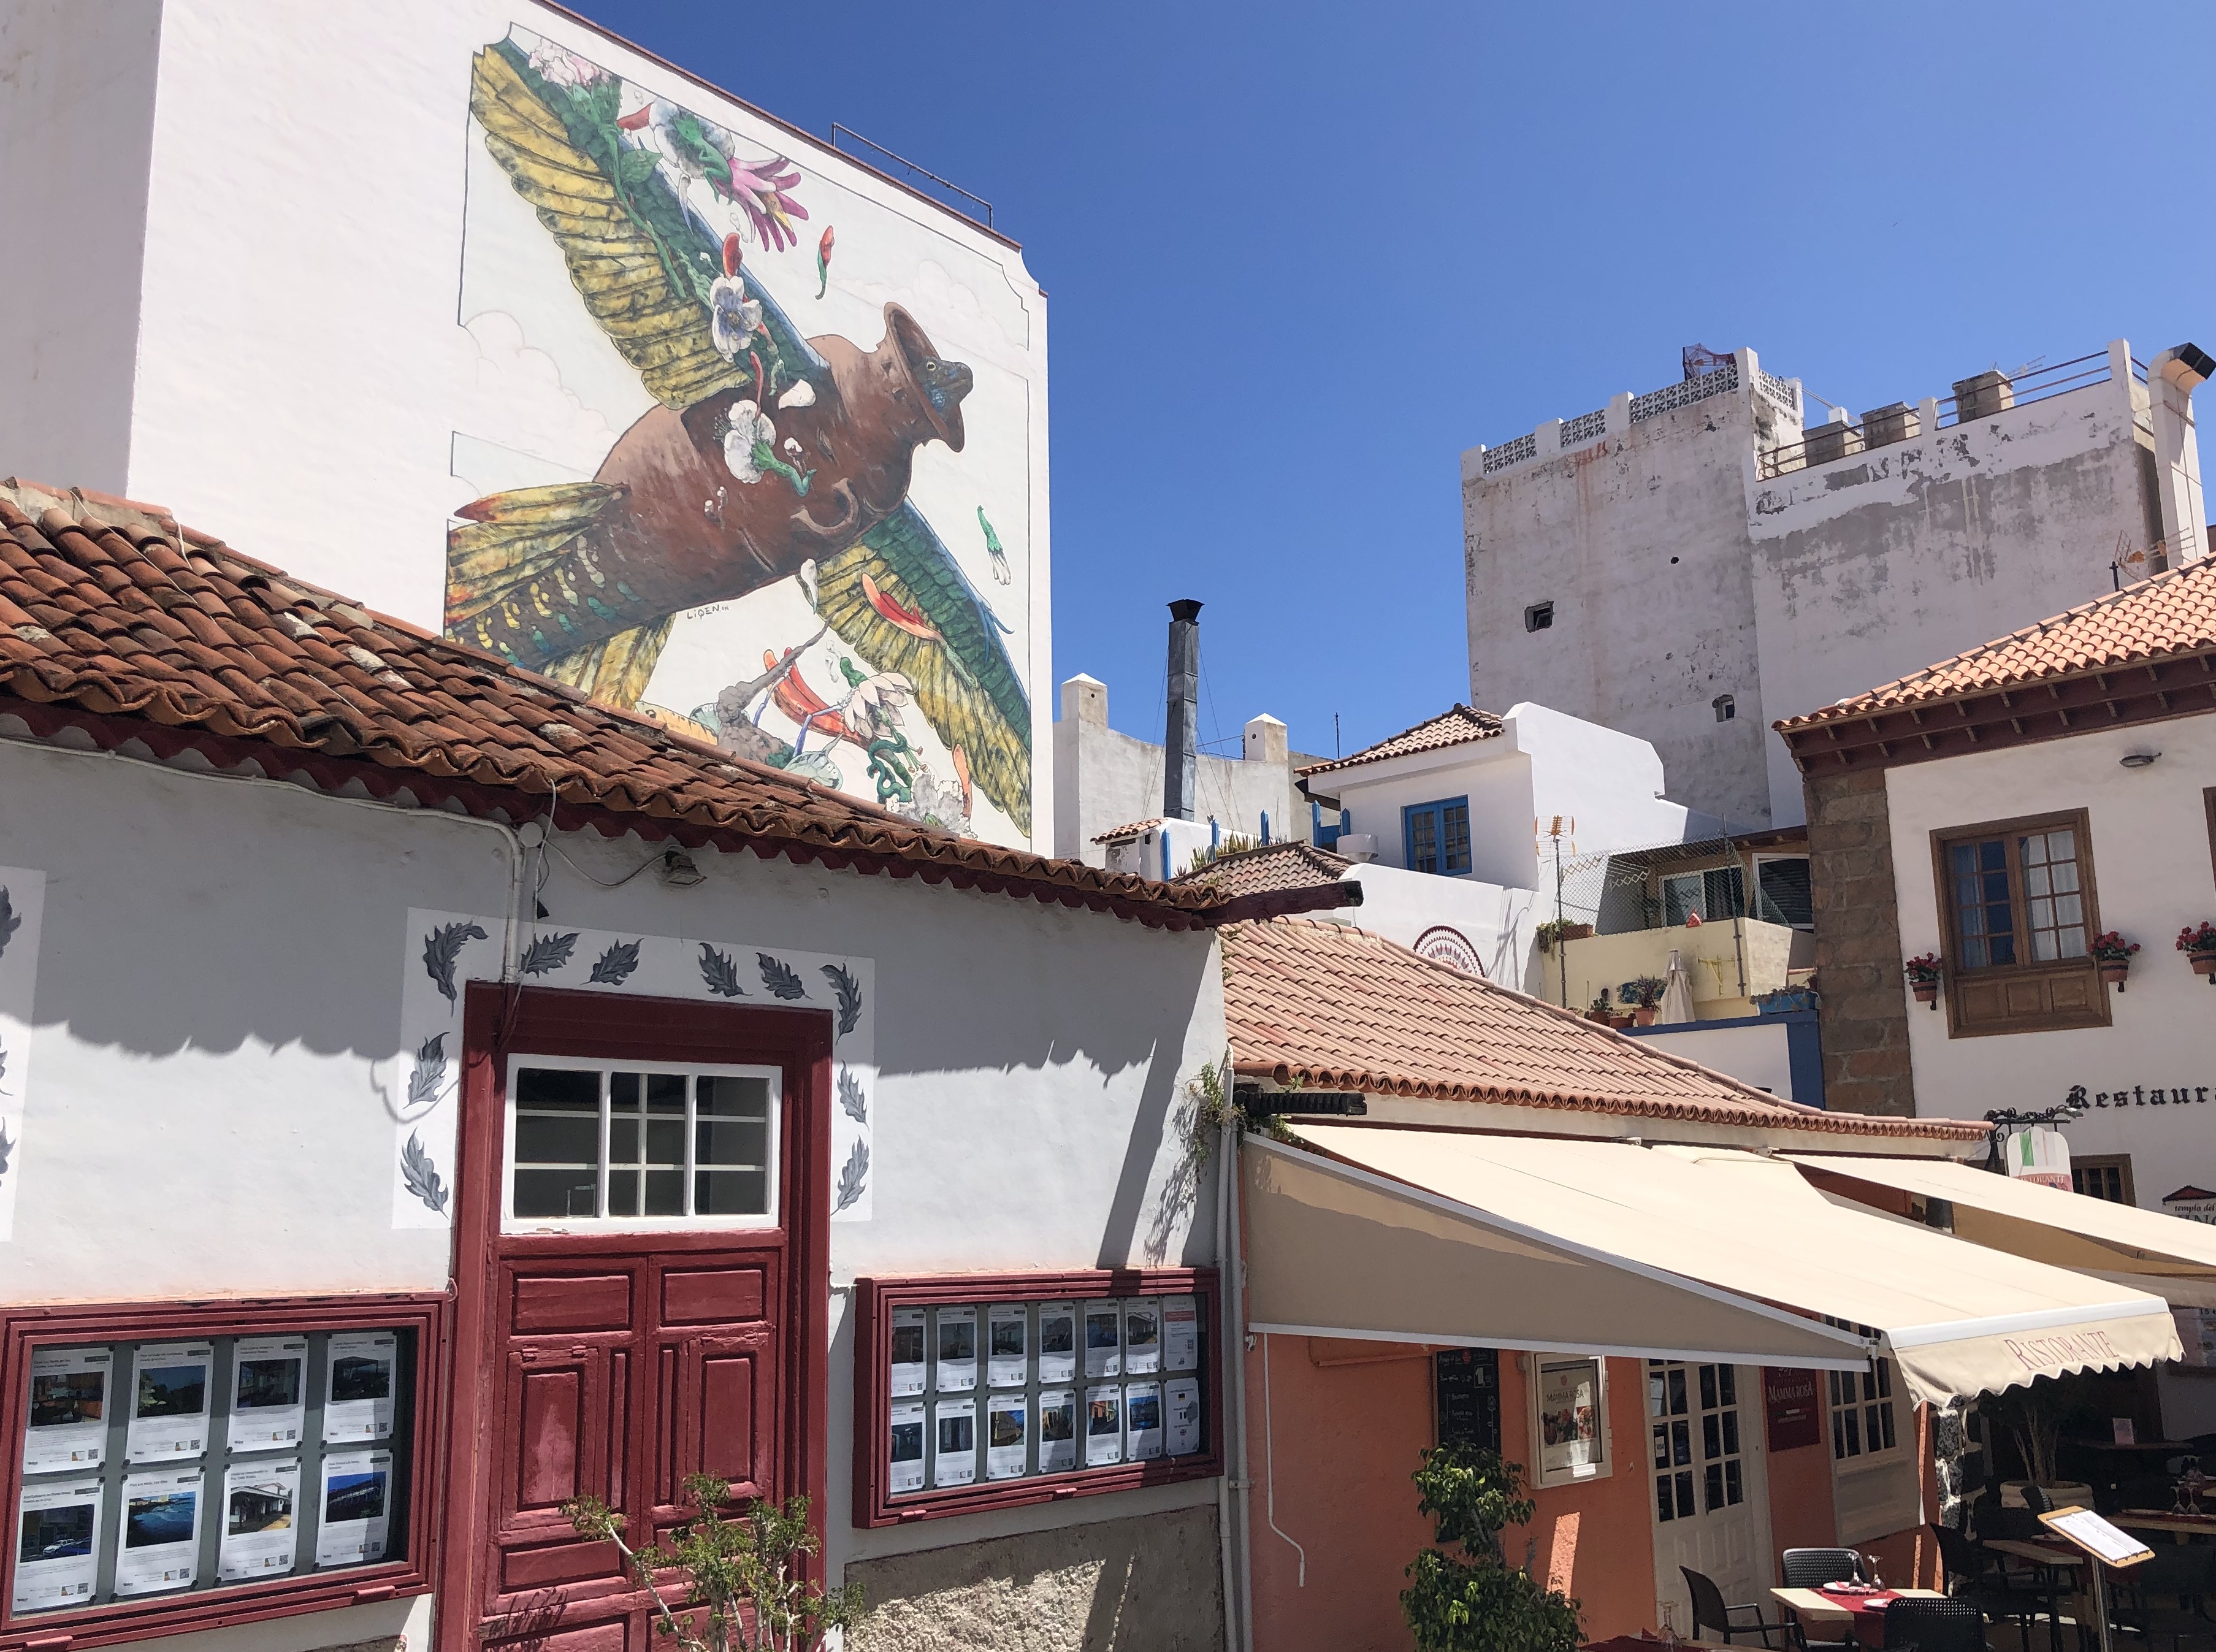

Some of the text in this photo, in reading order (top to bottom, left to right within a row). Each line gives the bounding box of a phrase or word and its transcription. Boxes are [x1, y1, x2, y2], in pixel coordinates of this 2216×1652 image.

[2065, 1084, 2216, 1109] Restaur
[2003, 1331, 2120, 1371] RISTORANTE
[1570, 1389, 1584, 1399] ROSA
